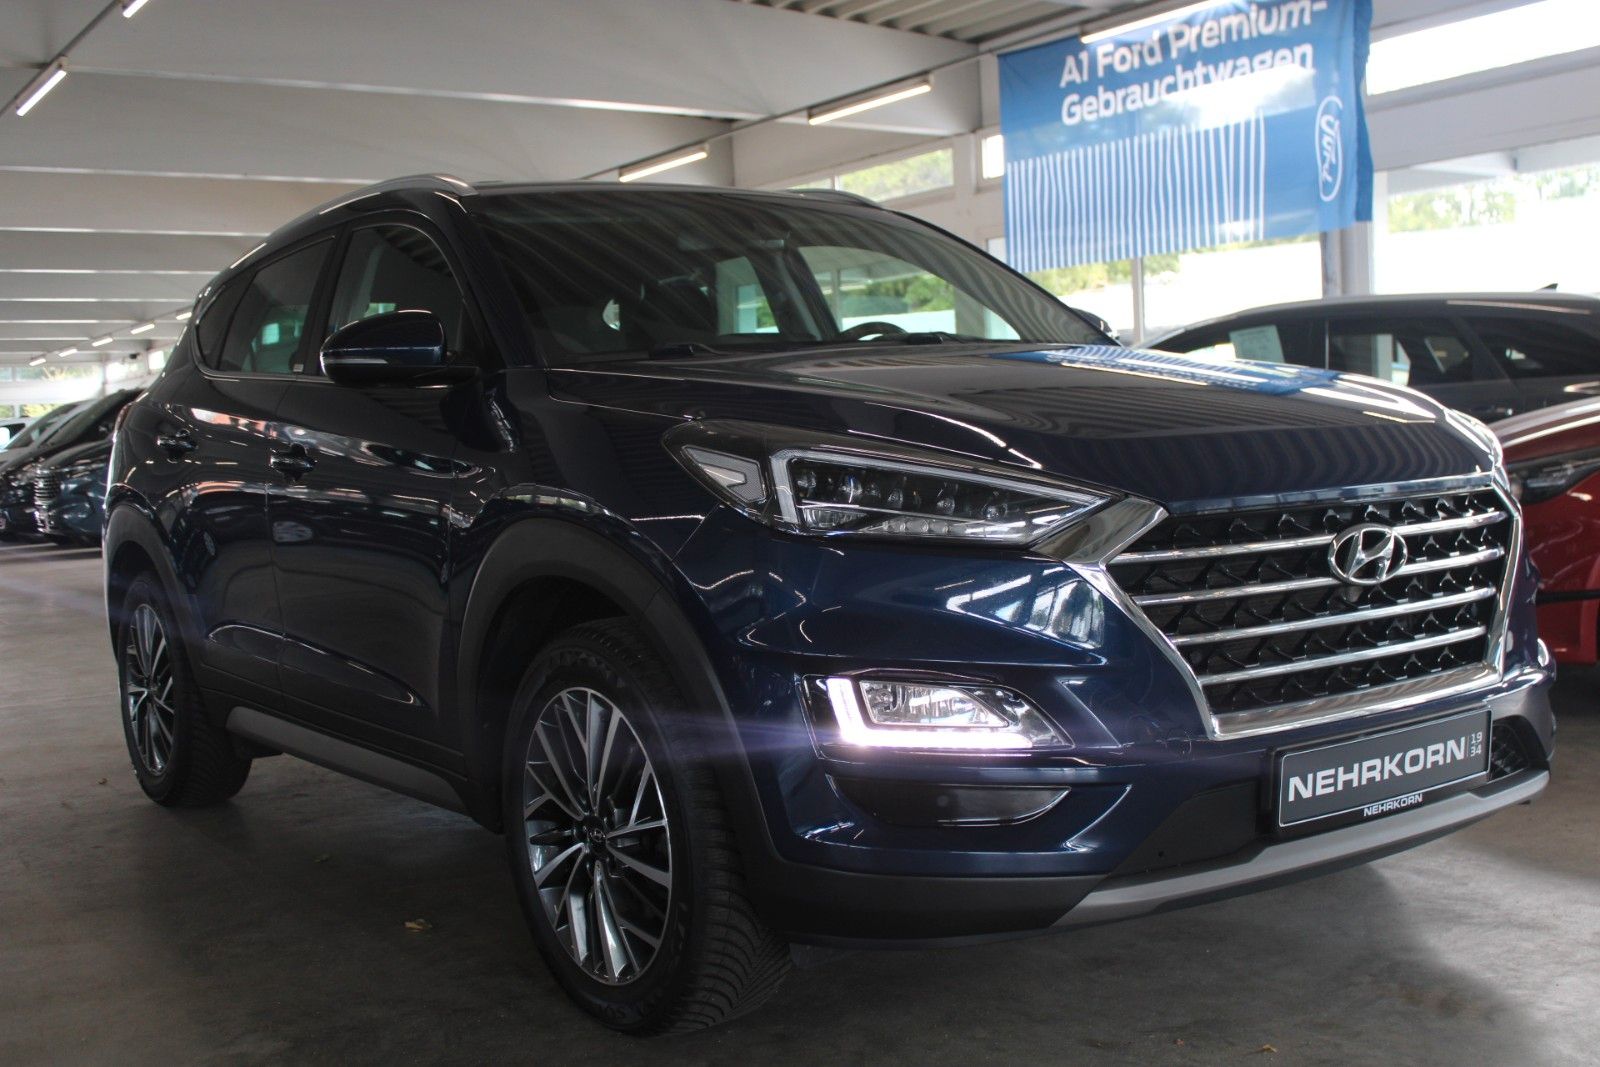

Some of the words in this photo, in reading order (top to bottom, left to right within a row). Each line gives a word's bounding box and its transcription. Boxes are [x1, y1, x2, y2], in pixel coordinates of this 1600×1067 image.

[1059, 50, 1089, 88] A1
[1096, 30, 1162, 78] Ford
[1167, 0, 1328, 59] Premium-
[1288, 735, 1467, 802] NEHRKORN
[1470, 731, 1483, 744] 19
[1363, 793, 1423, 817] NEHRKORN
